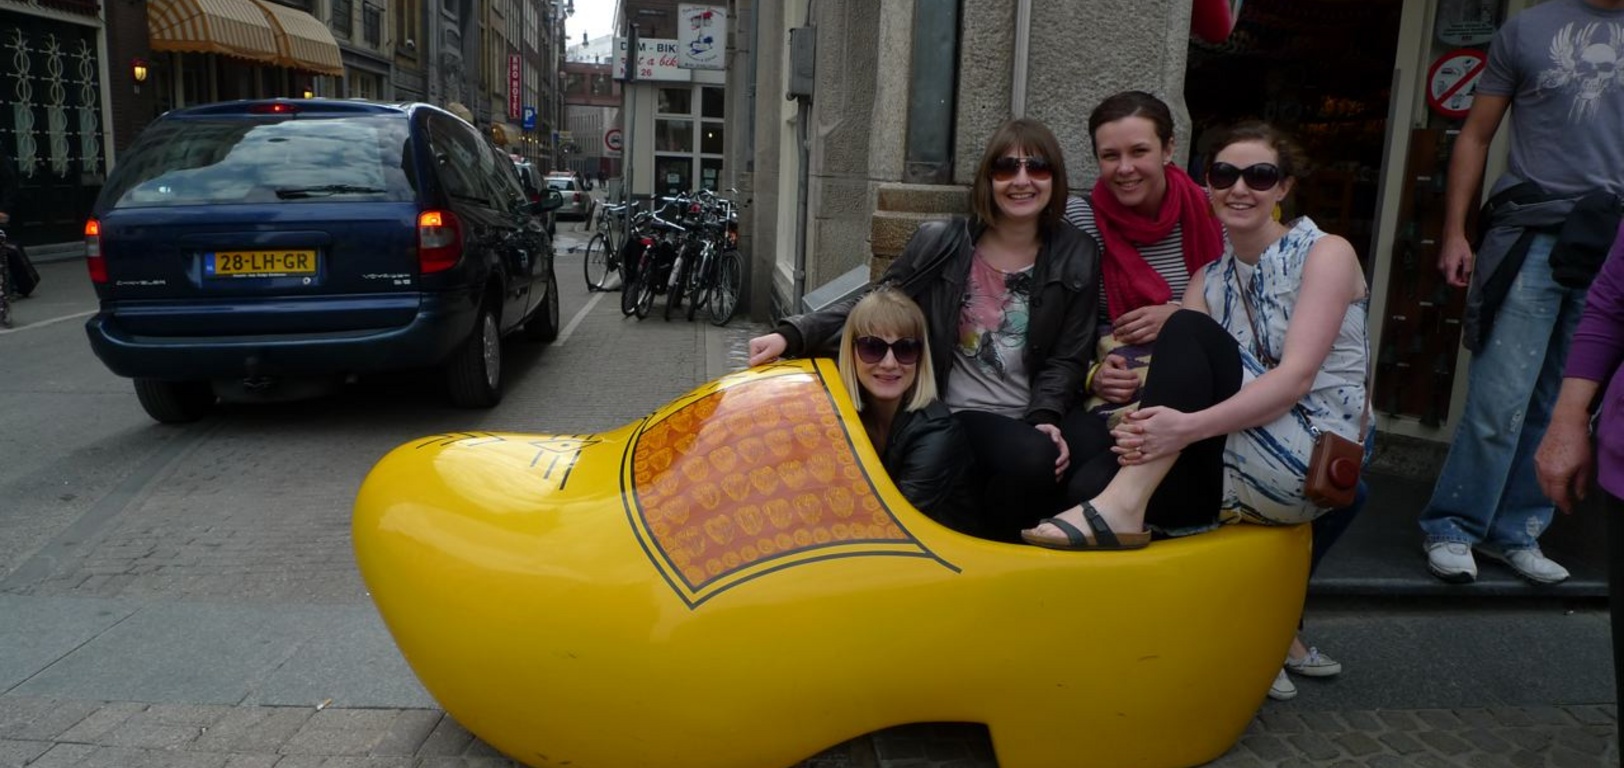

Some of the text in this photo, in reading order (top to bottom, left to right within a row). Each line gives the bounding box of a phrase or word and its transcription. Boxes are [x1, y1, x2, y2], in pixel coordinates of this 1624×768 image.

[620, 42, 646, 51] DM
[657, 43, 677, 53] BIK
[659, 55, 679, 67] bik
[641, 69, 652, 77] 26
[525, 109, 533, 121] P
[221, 253, 308, 271] 28-LH-GR
